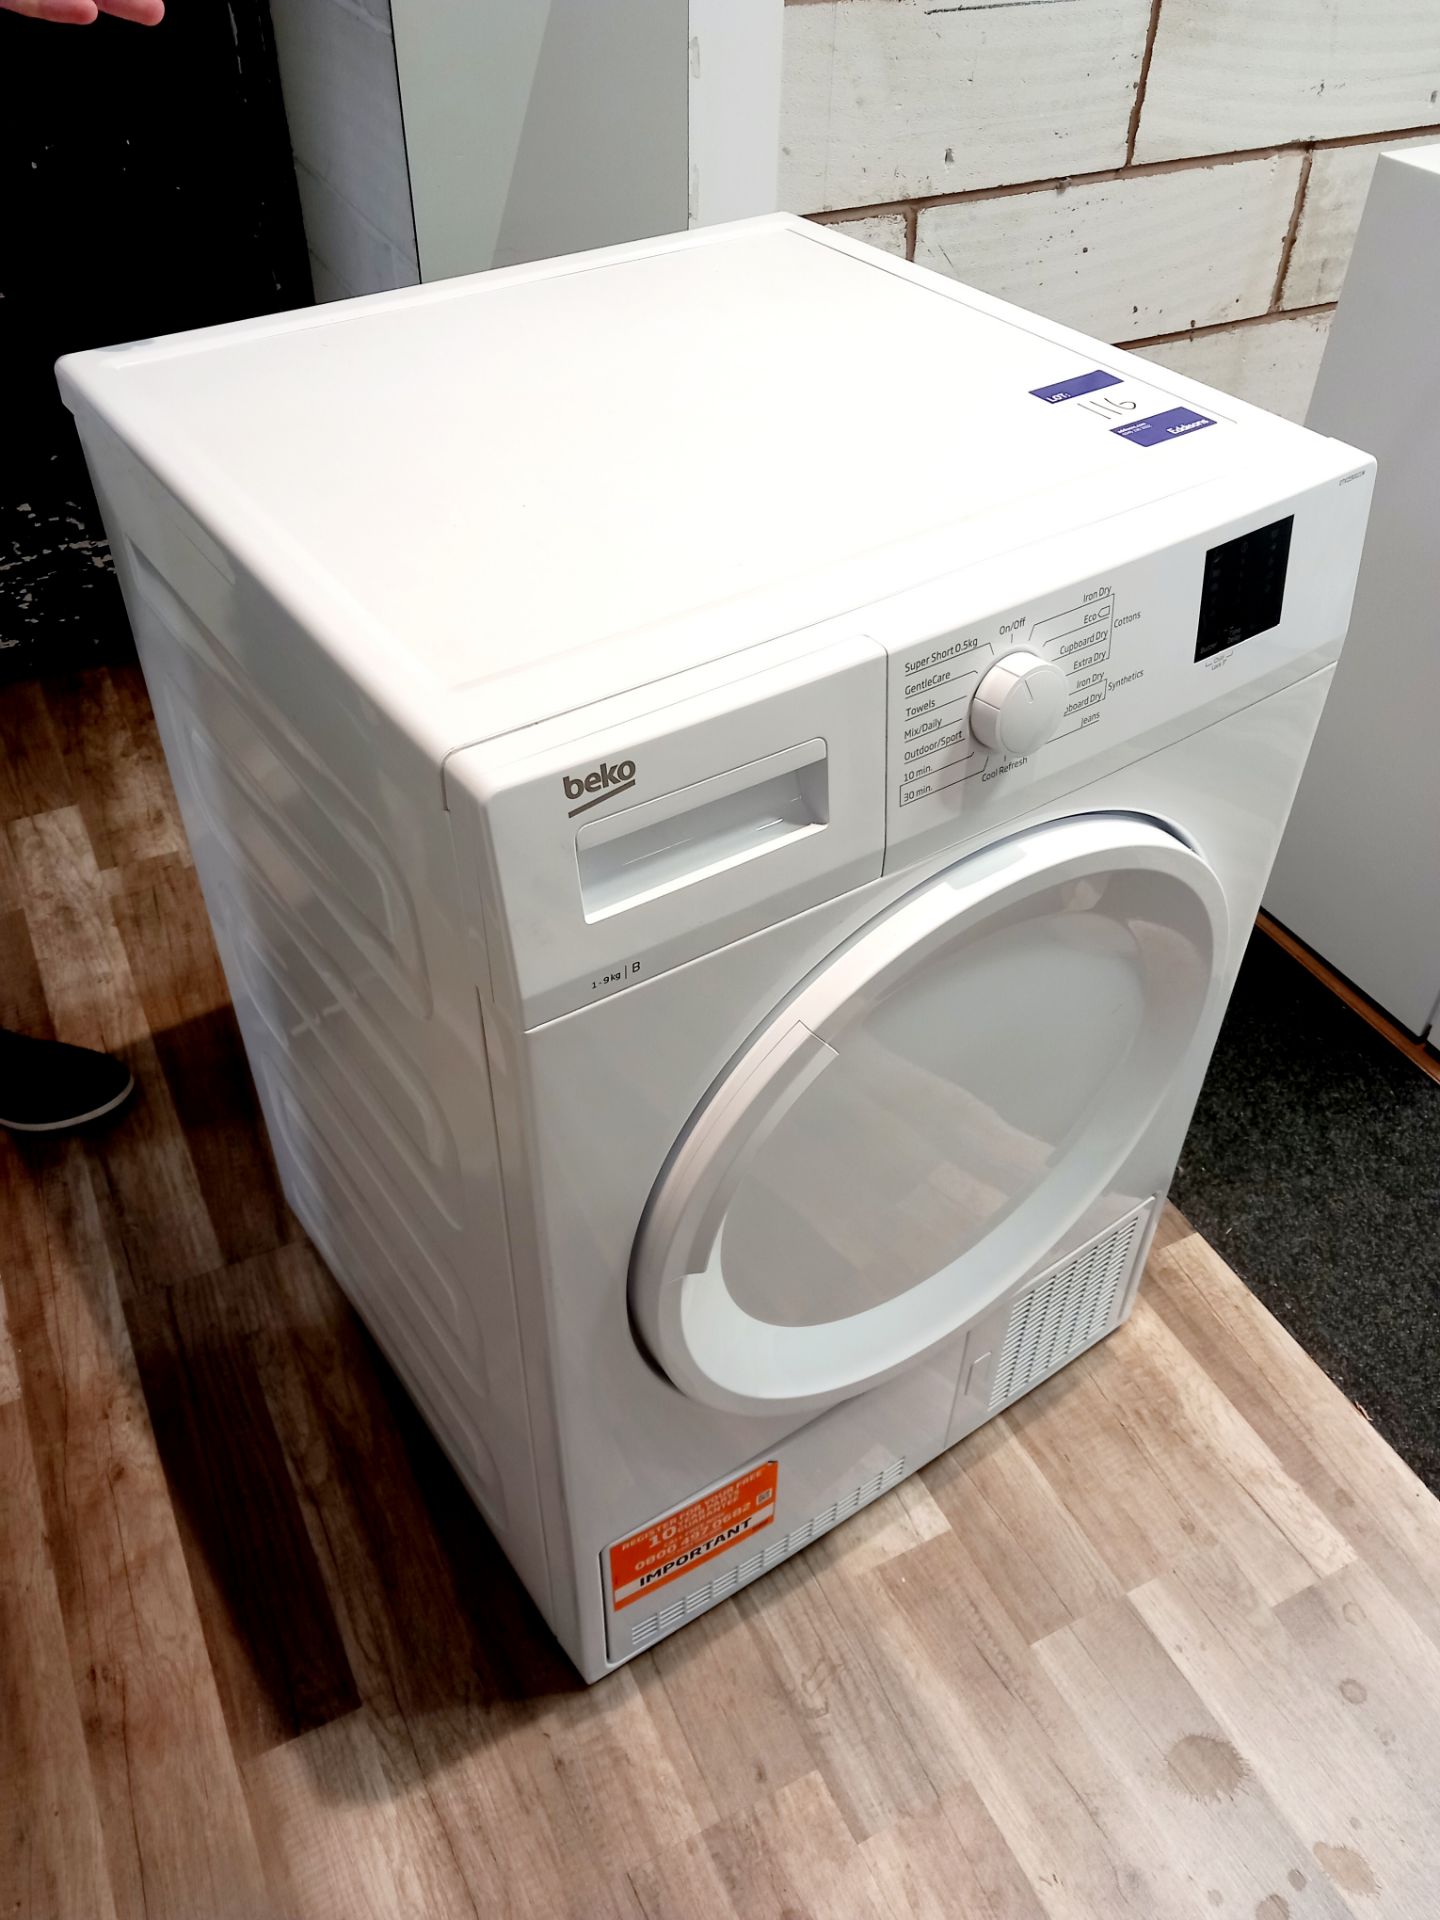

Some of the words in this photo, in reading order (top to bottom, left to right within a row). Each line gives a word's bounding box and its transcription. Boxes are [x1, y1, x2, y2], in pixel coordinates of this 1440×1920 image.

[1076, 397, 1137, 420] 116
[1083, 591, 1098, 603] Iron
[1098, 586, 1112, 597] Dry
[999, 616, 1026, 635] On/Off
[1083, 613, 1097, 624] Eco
[1113, 611, 1142, 628] Cottons
[1060, 635, 1095, 654] Cupboard
[1095, 630, 1109, 641] Dry
[904, 656, 930, 673] Super
[930, 646, 954, 663] Short
[954, 637, 979, 653] 0.5kg
[1073, 656, 1093, 670] Extra
[1093, 651, 1107, 662] Dry
[904, 671, 951, 695] GentleCare
[1076, 678, 1091, 689] Iron
[1091, 672, 1105, 682] Dry
[1108, 669, 1144, 691] Synthetics
[1089, 692, 1103, 703] Dry
[905, 699, 936, 717] Towels
[904, 718, 943, 740] Mix/Daily
[904, 731, 962, 761] Outdoor/Sport
[903, 771, 915, 782] 10
[981, 771, 998, 782] Cool
[999, 757, 1028, 775] Refresh
[562, 760, 636, 800] beko
[903, 791, 915, 803] 30
[632, 961, 641, 973] B
[648, 1523, 676, 1548] 10
[639, 1516, 752, 1587] IMPORTANT
